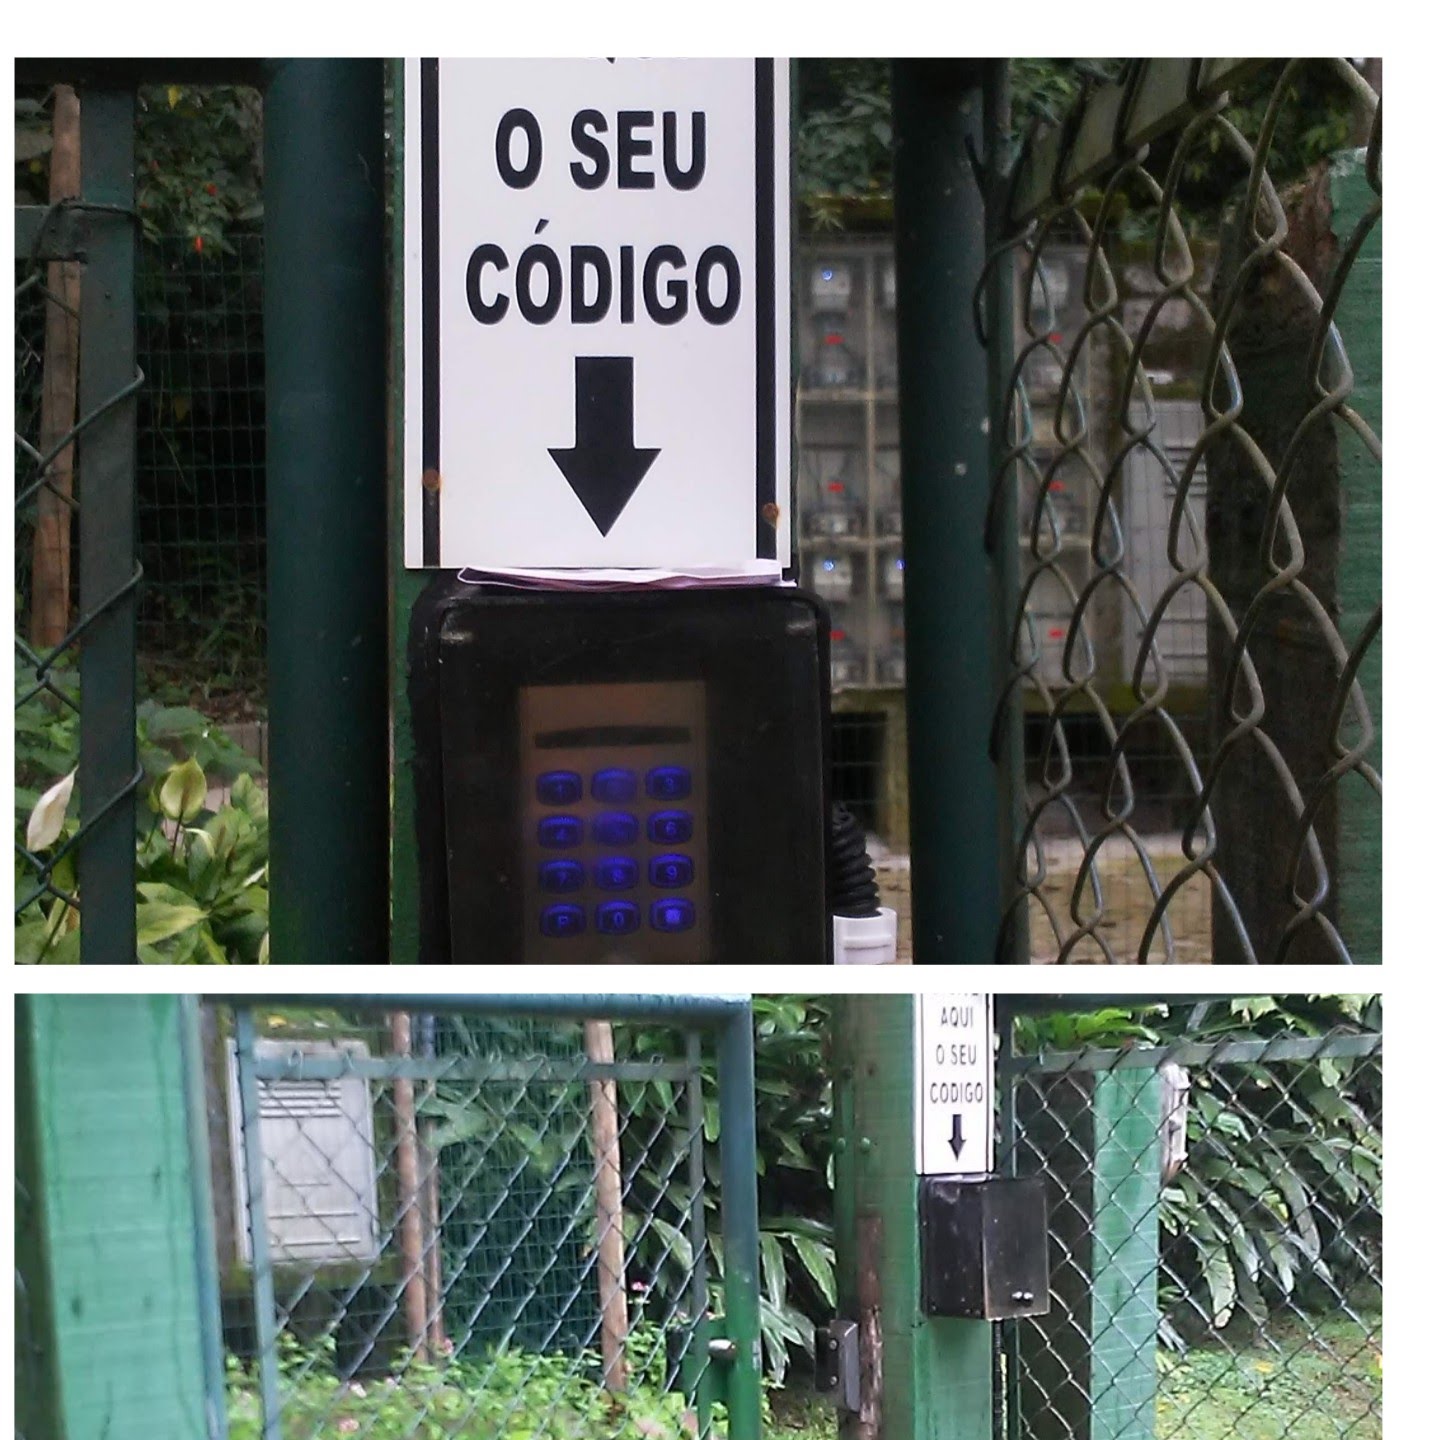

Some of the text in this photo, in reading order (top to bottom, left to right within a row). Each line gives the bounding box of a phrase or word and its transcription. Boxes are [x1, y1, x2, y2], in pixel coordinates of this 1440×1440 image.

[495, 108, 707, 191] O SEU
[466, 218, 741, 326] CÓDIGO
[940, 1006, 974, 1027] AQUI
[936, 1044, 977, 1066] O SEU
